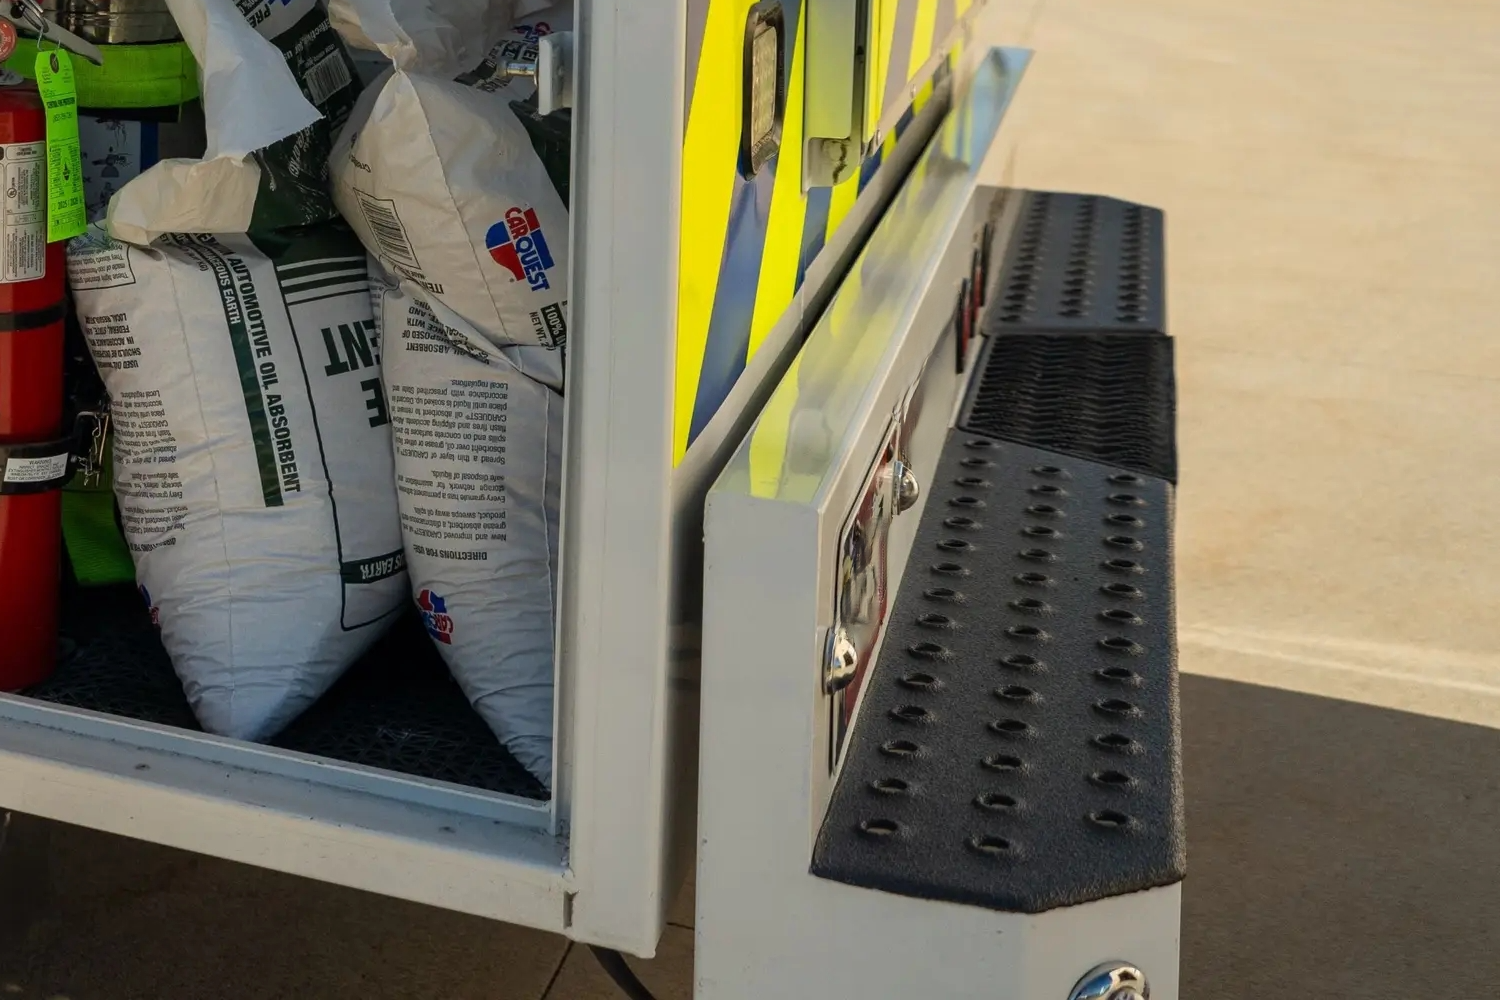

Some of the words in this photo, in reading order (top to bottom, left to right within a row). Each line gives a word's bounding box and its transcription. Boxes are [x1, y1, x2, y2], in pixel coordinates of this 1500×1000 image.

[504, 206, 550, 292] CARQUEST
[224, 288, 240, 324] EARTH
[228, 258, 273, 359] AUTOMOTIVE
[408, 306, 426, 317] AND
[110, 312, 127, 322] LOCAL
[529, 311, 542, 326] NET
[545, 306, 562, 335] 100%
[407, 317, 425, 327] WITH
[402, 330, 410, 338] OF
[117, 348, 142, 356] SHOULD
[405, 342, 450, 353] ABSORBENT
[122, 360, 139, 369] USED
[259, 362, 279, 390] OIL
[490, 382, 508, 390] Local
[146, 390, 160, 398] Local
[417, 388, 447, 396] prescribed
[451, 390, 465, 398] with
[468, 390, 508, 400] accordance
[424, 398, 445, 407] soaked
[453, 400, 471, 409] liquid
[473, 402, 487, 410] until
[489, 402, 507, 411] place
[423, 409, 452, 418] absorbent
[432, 419, 456, 429] slipping
[472, 423, 488, 432] fires
[490, 424, 506, 433] flash
[411, 429, 433, 437] surfaces
[435, 432, 461, 440] concrete
[266, 394, 301, 493] ABSORBENT
[425, 441, 444, 449] grease
[457, 444, 470, 452] over
[472, 445, 506, 454] absorbent
[439, 452, 454, 461] layer
[458, 454, 469, 462] thin
[481, 455, 505, 465] Spread
[462, 473, 489, 481] disposal
[490, 474, 505, 482] safe
[449, 483, 475, 491] network
[480, 484, 505, 493] storage
[170, 491, 183, 499] Every
[487, 495, 505, 503] Every
[435, 509, 450, 517] away
[444, 532, 472, 540] improved
[491, 533, 507, 541] New
[425, 548, 438, 557] FOR
[440, 550, 487, 560] DIRECTIONS
[360, 558, 393, 579] EARTH
